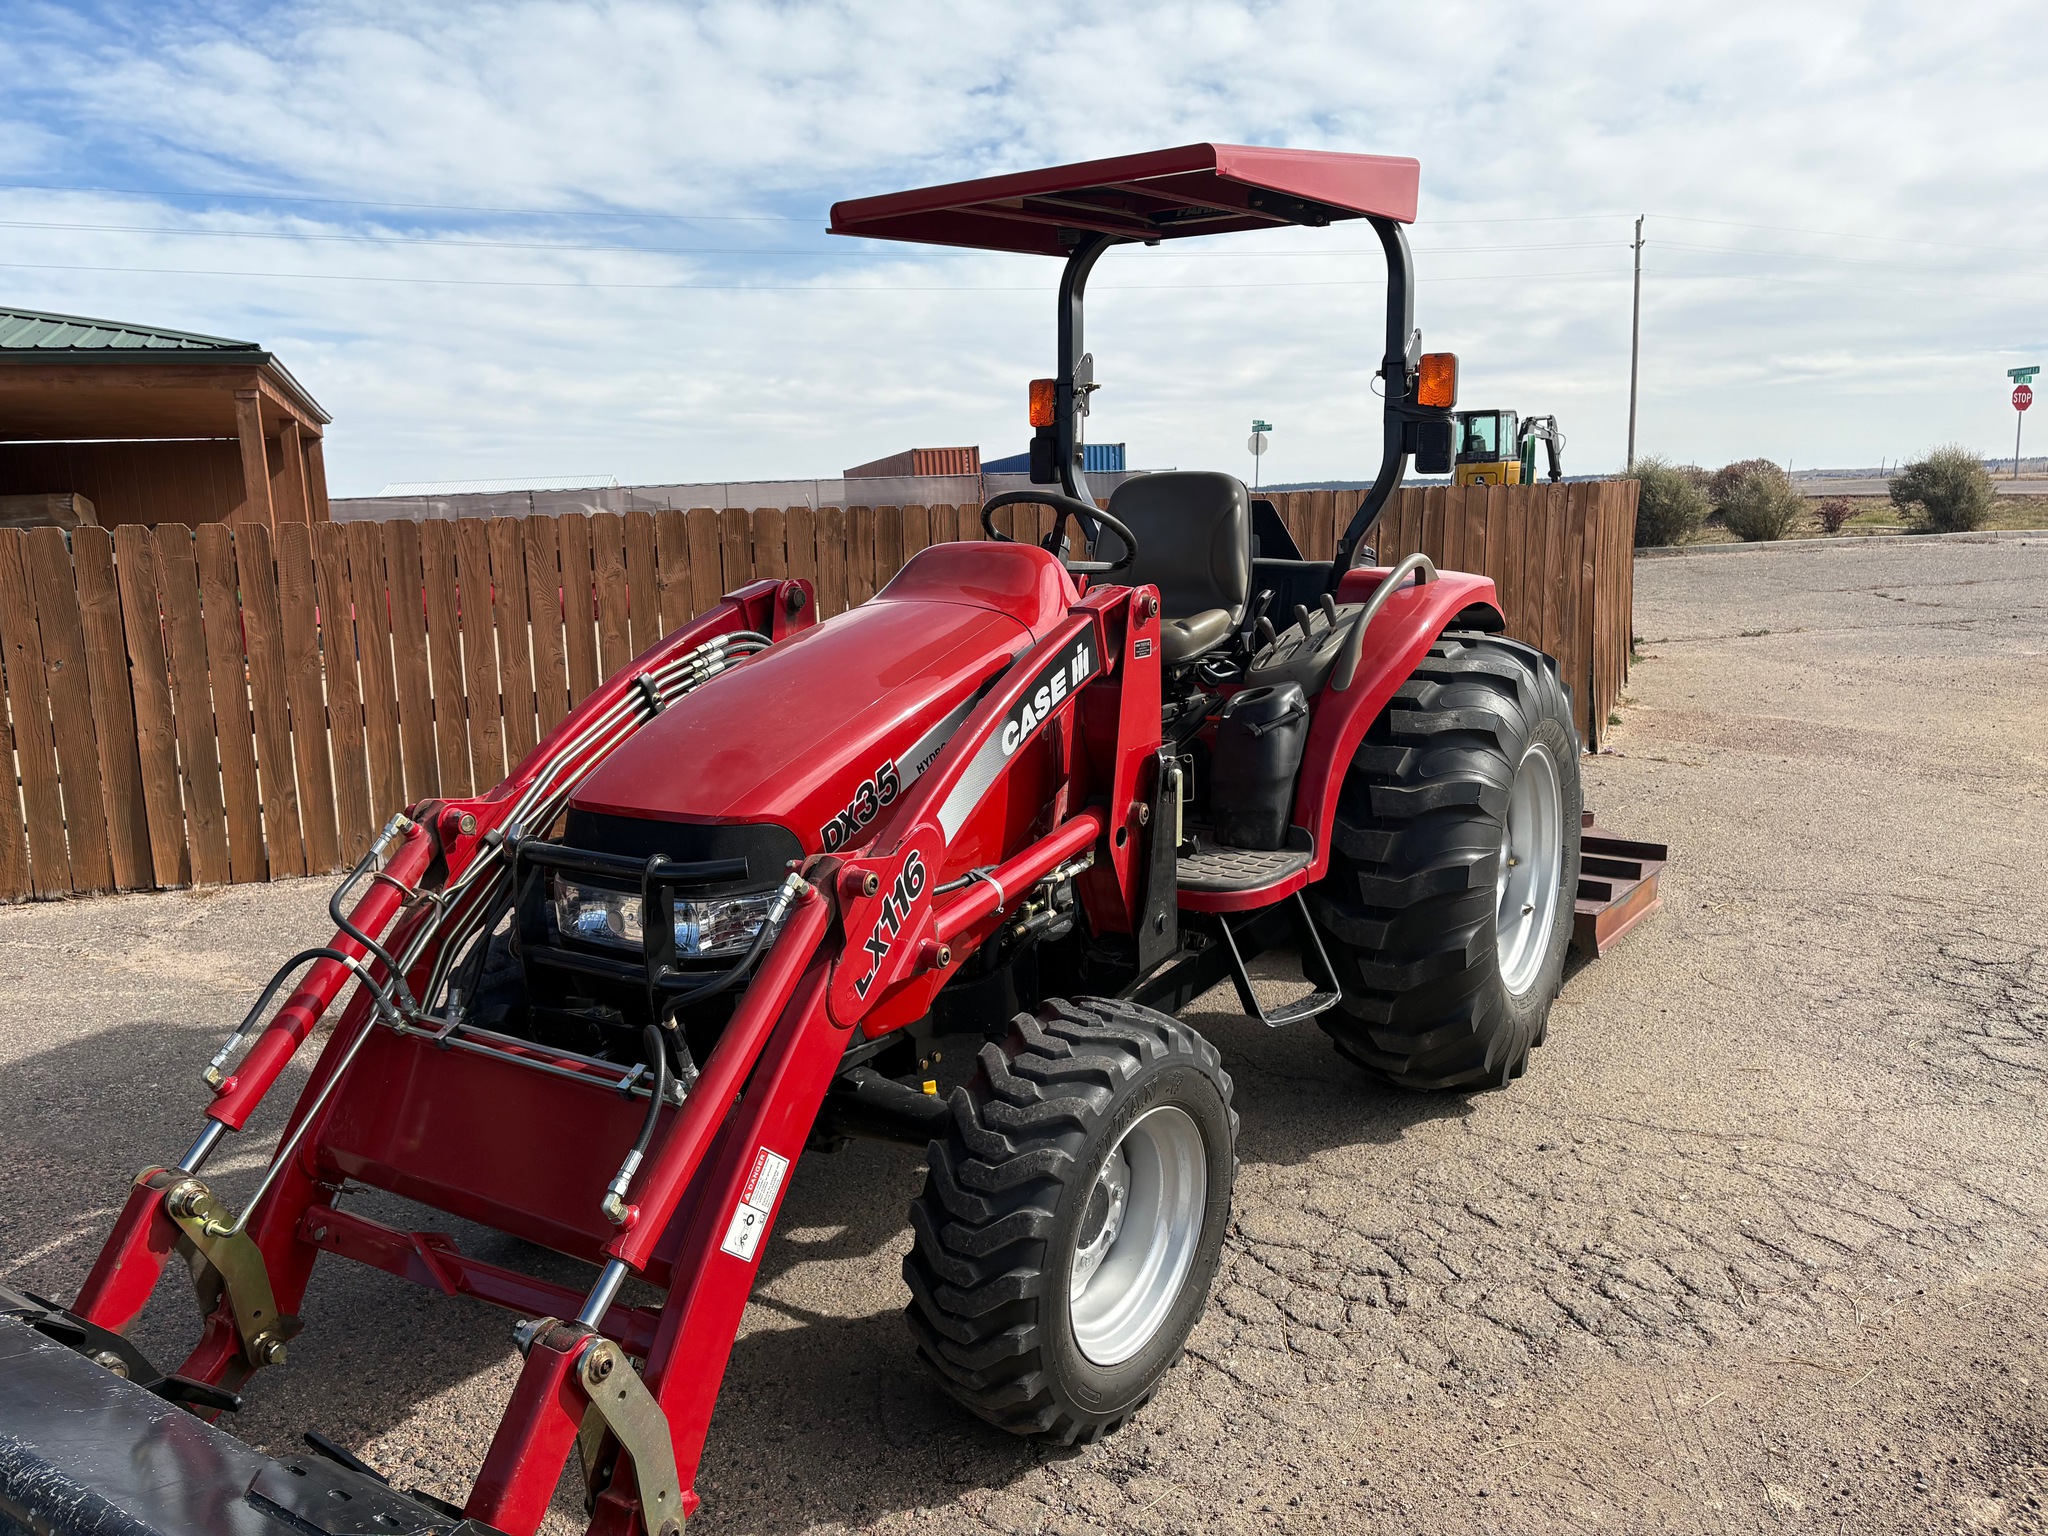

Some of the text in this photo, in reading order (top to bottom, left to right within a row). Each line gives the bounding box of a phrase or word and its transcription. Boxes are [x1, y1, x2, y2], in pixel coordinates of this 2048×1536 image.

[2013, 393, 2031, 403] STOP
[1002, 667, 1067, 756] CASE
[819, 757, 900, 854] DX35
[853, 849, 927, 1002] LX116
[748, 1154, 766, 1191] DANGER
